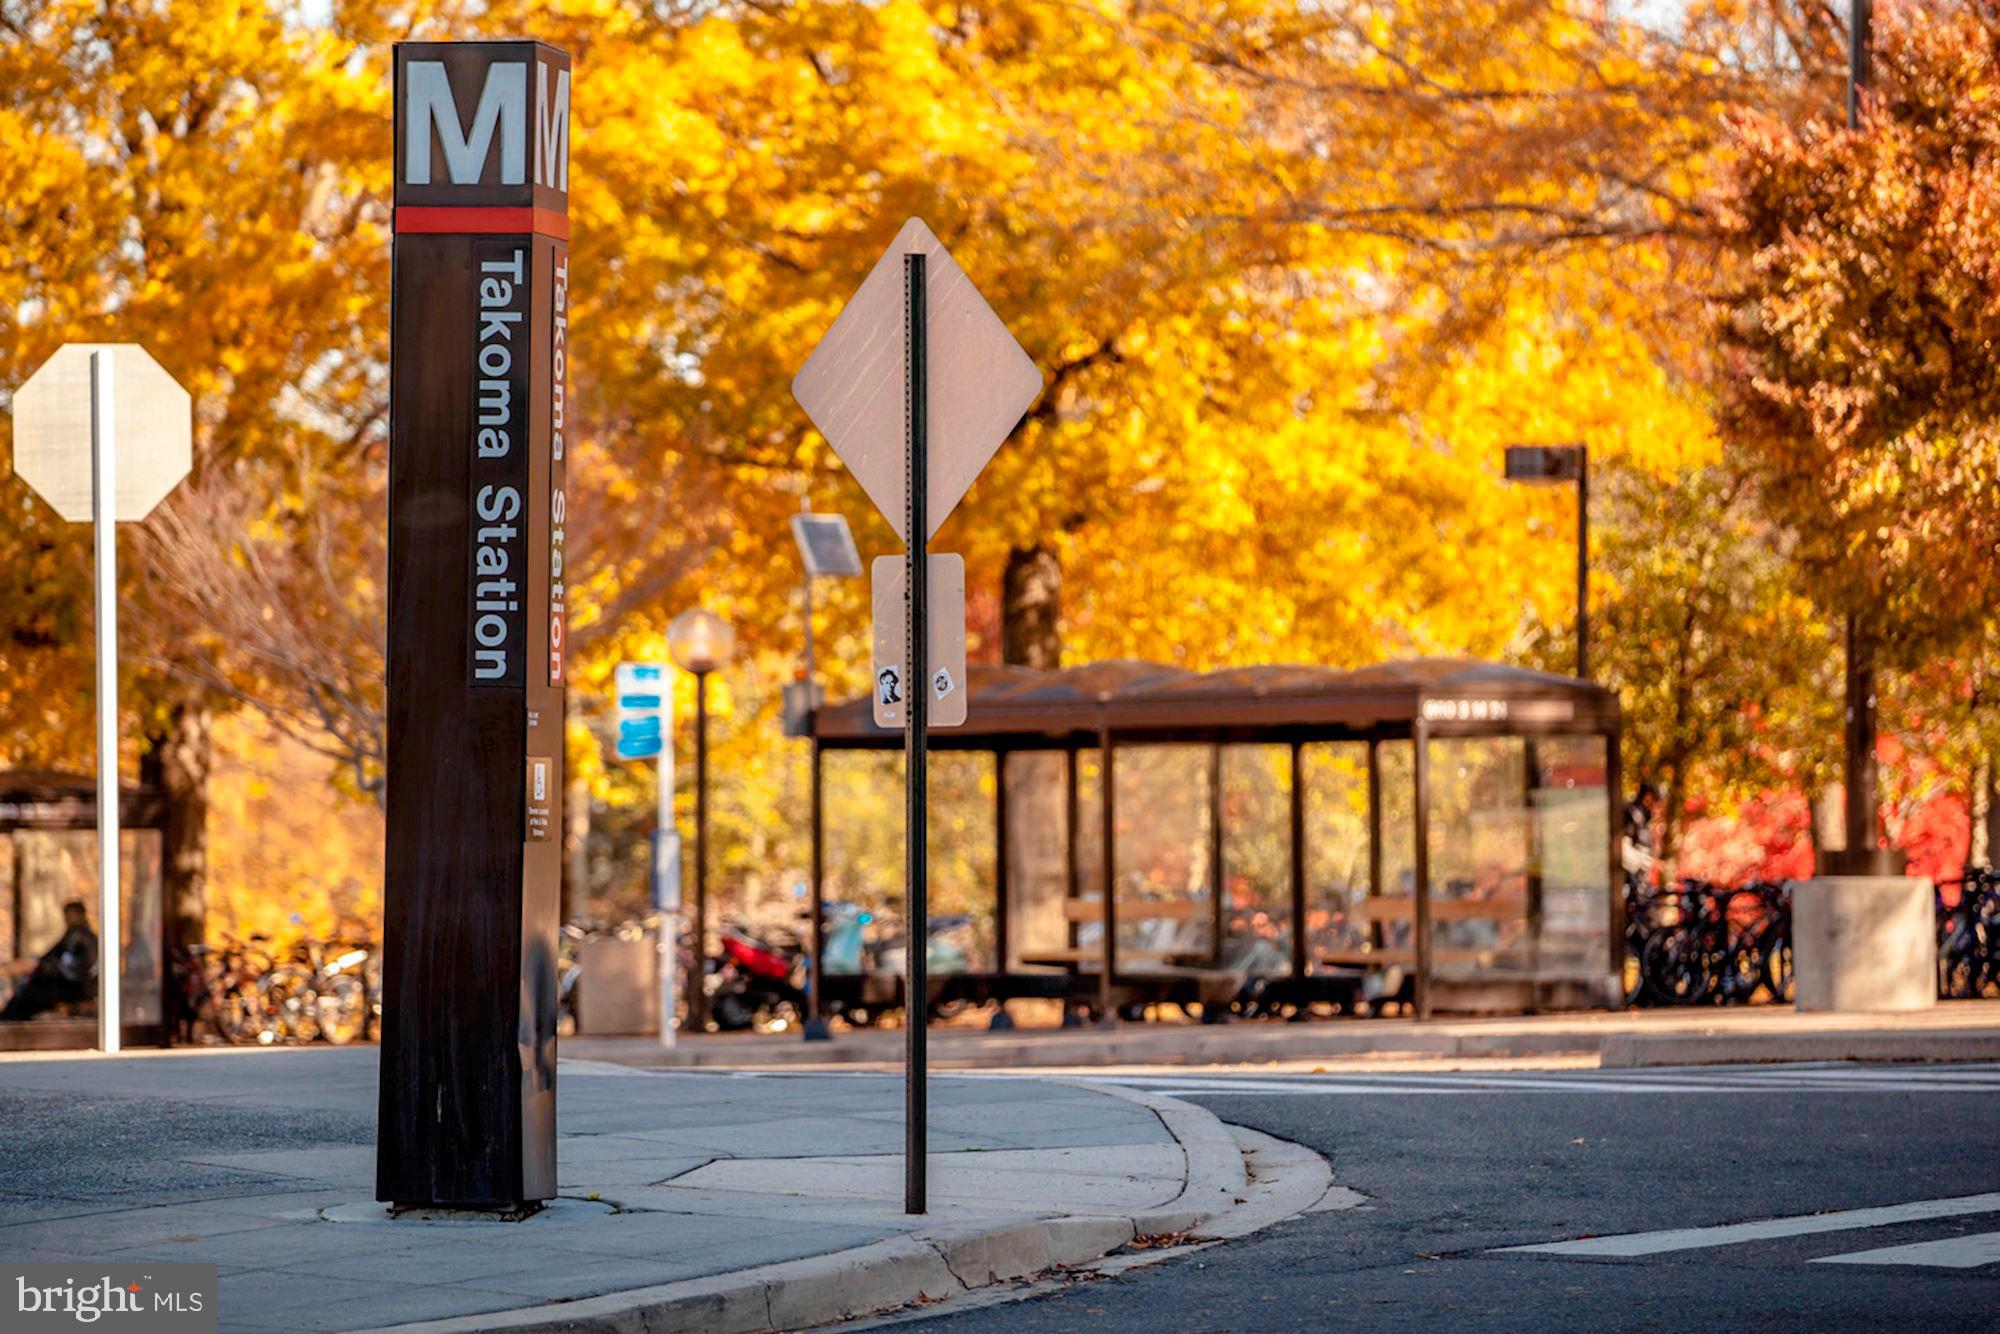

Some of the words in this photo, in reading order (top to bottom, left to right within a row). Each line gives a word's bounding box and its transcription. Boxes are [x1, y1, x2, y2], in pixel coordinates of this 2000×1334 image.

[405, 60, 527, 185] M
[534, 60, 570, 193] M
[477, 249, 524, 458] Takoma
[553, 256, 568, 460] Takoma
[474, 484, 522, 679] Station
[550, 488, 565, 680] Station
